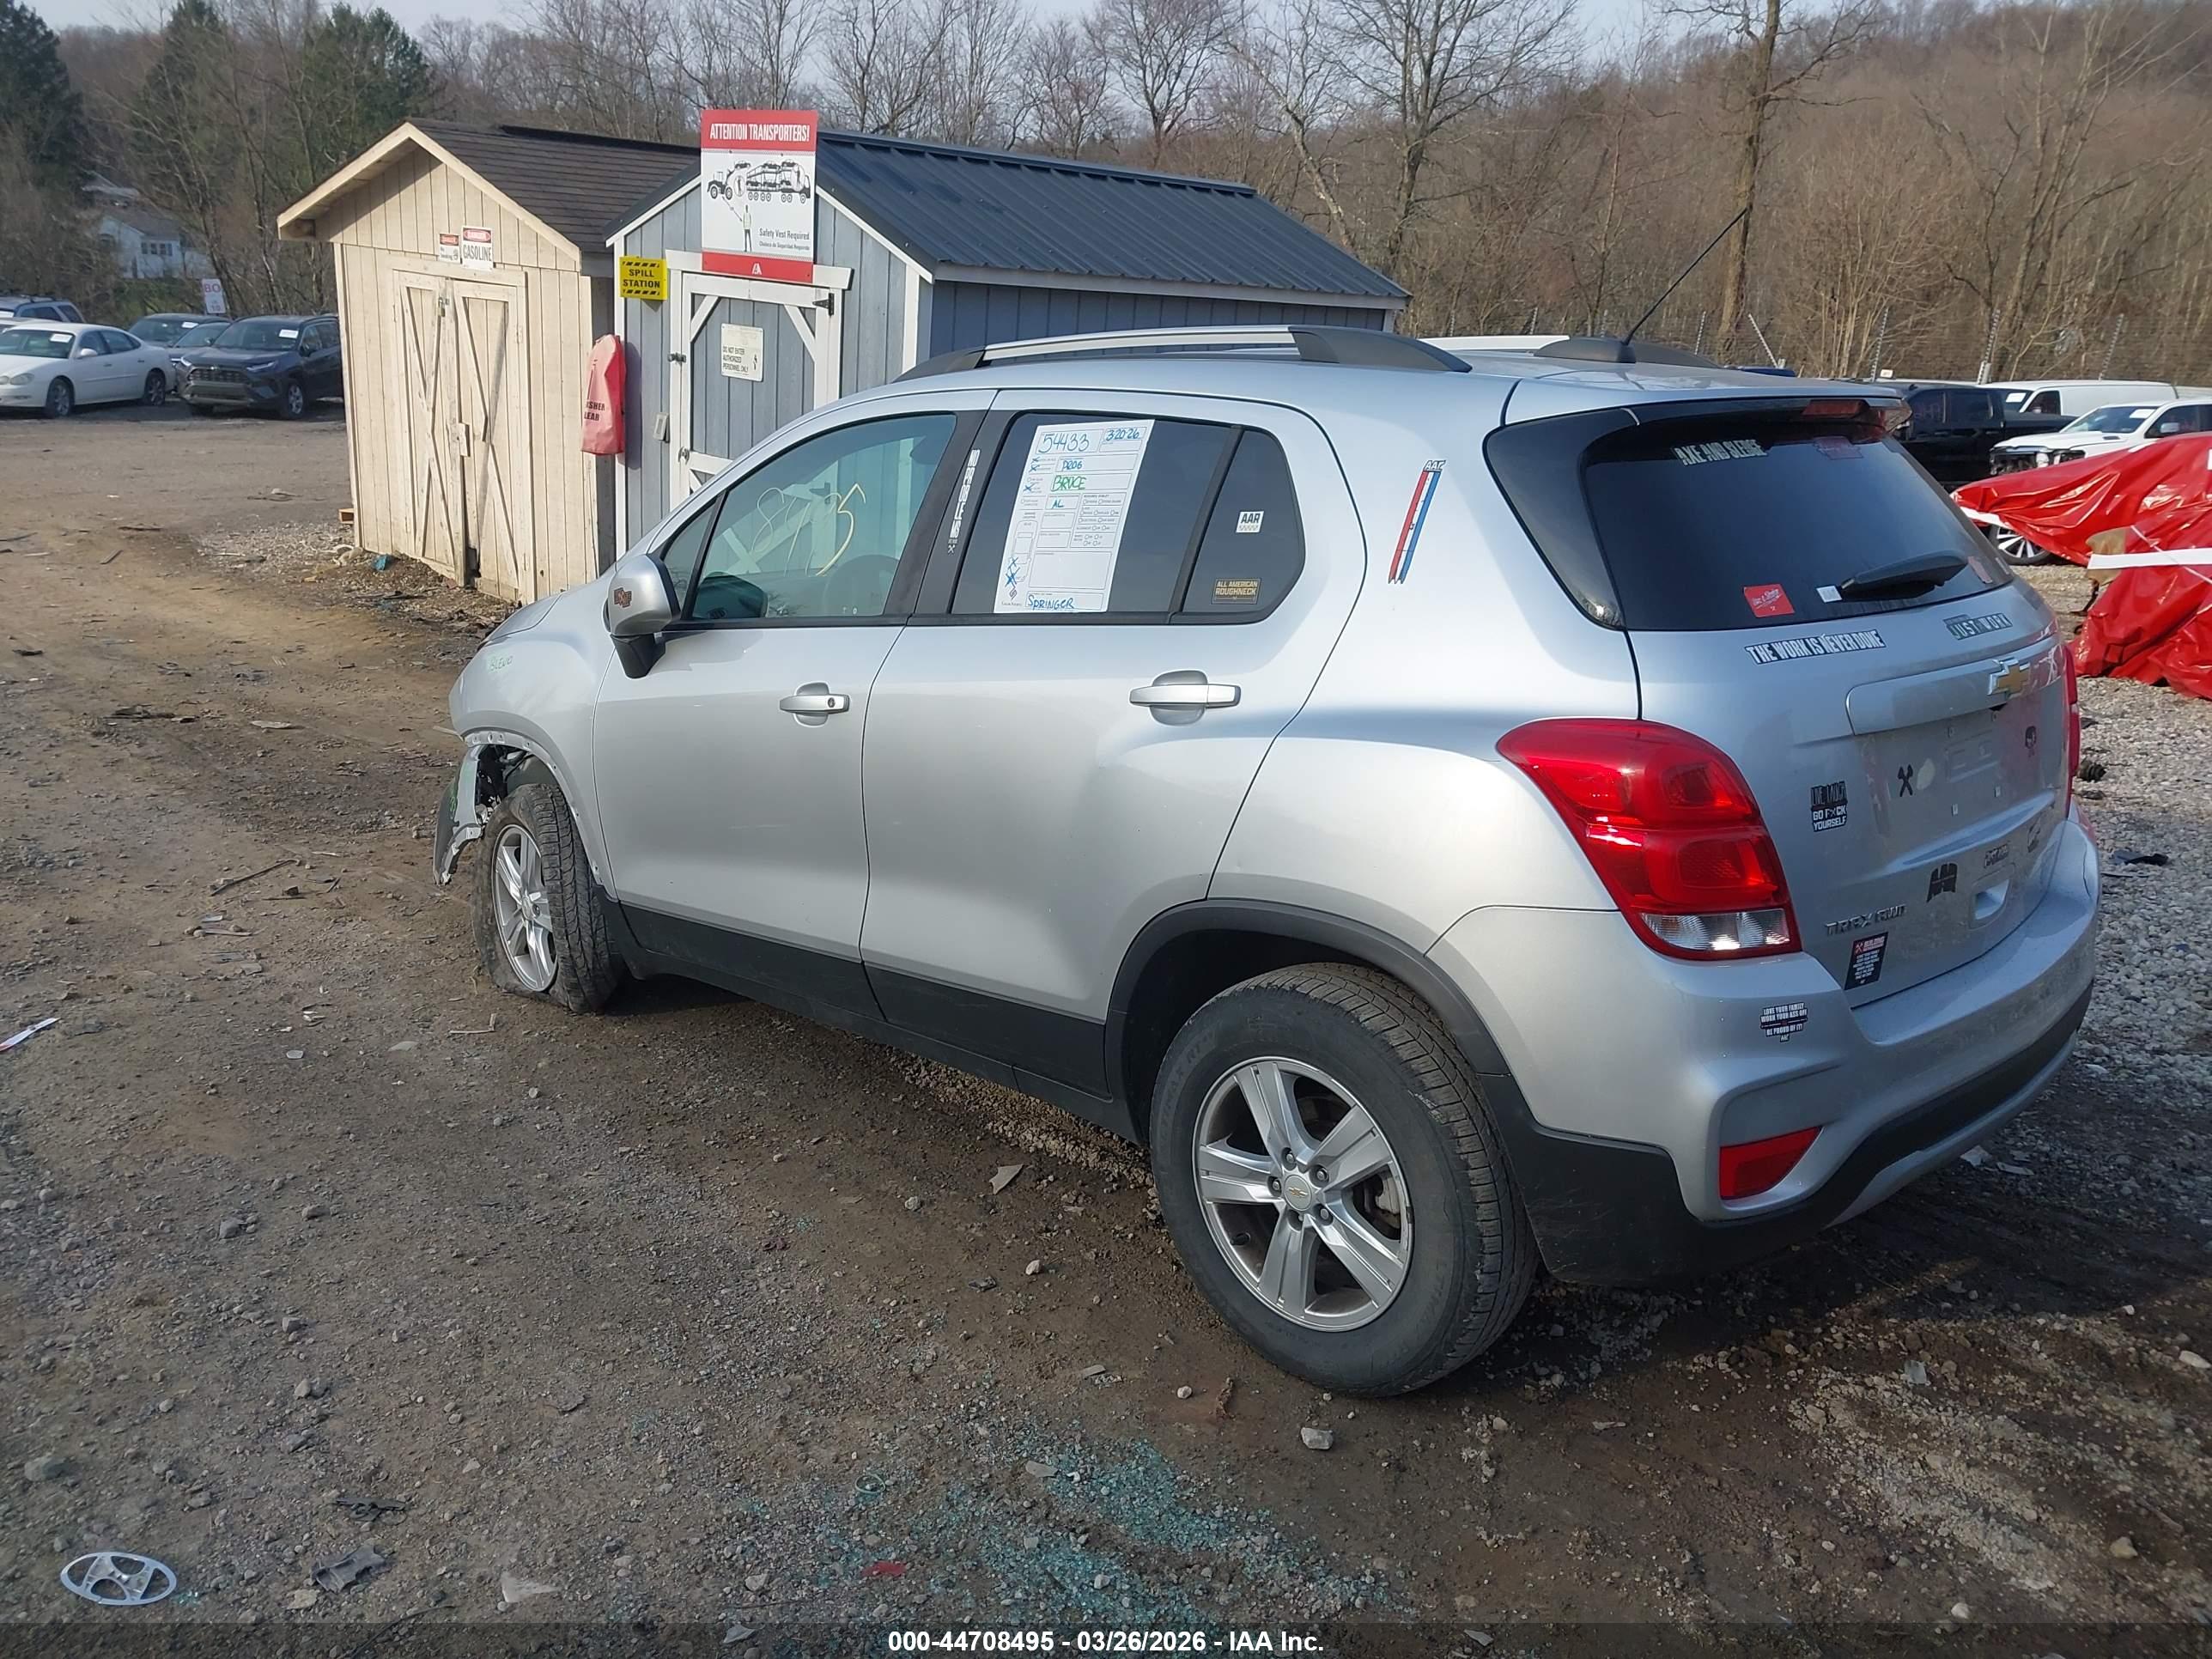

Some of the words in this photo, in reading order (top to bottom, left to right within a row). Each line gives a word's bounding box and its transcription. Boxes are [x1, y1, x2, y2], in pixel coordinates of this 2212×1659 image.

[710, 123, 747, 140] ATTENTION
[748, 124, 810, 142] TRANSPORTERS!
[759, 228, 775, 240] Safety
[775, 229, 786, 238] Vest
[787, 230, 810, 241] Required
[463, 244, 492, 261] GASOLINE
[629, 268, 654, 277] SPILL
[623, 279, 660, 289] STATION
[1038, 433, 1090, 453] 54433
[1050, 475, 1086, 492] BRUCE
[1240, 513, 1261, 524] AAR
[1215, 587, 1257, 596] ROUGHNECK
[1027, 594, 1075, 611] SPRINGER
[1949, 620, 1981, 639] JUST
[1978, 613, 2012, 630] WORK
[1746, 643, 1778, 664] THE
[1771, 638, 1812, 659] WORK
[1806, 637, 1824, 655] IS
[1819, 634, 1859, 653] NEVER
[1852, 630, 1886, 649] DONE
[1813, 810, 1824, 821] GO
[1813, 816, 1847, 830] YOURSELF
[1789, 1003, 1804, 1012] FAMILY
[1773, 1025, 1790, 1035] PROUD
